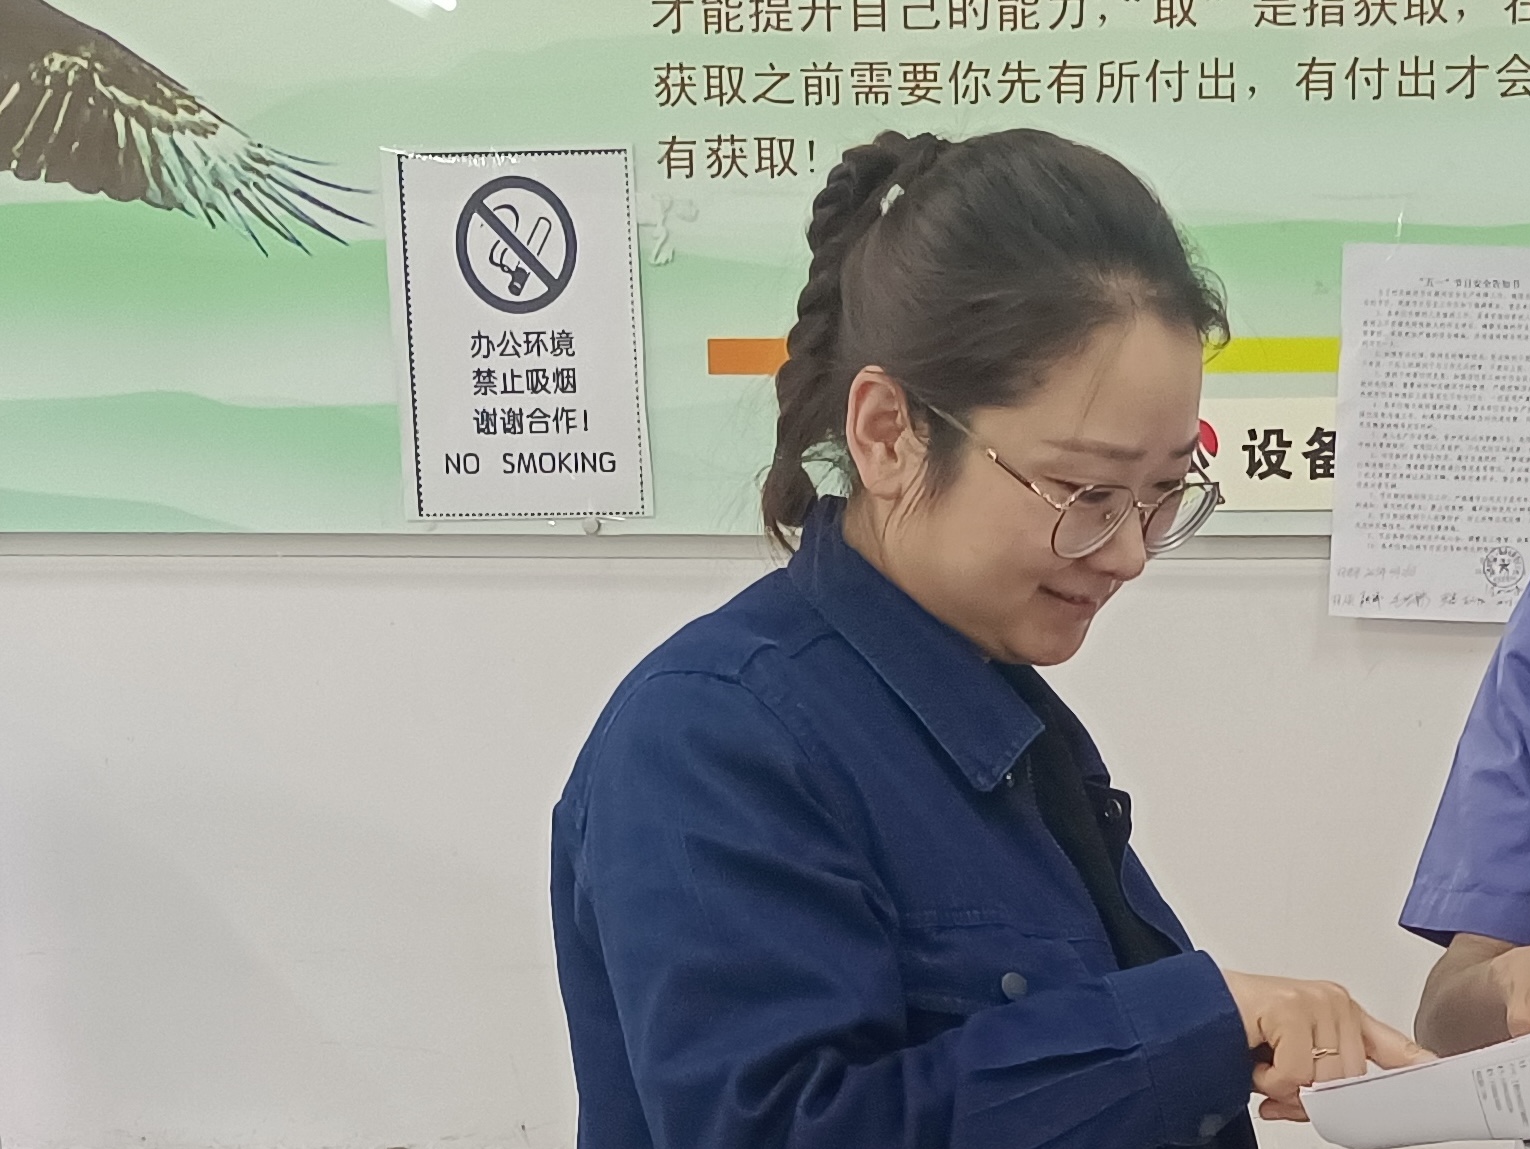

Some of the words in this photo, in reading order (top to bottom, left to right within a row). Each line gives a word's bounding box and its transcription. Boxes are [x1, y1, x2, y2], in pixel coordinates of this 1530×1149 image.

[470, 329, 576, 359] 办公环境
[472, 367, 577, 395] 禁止吸烟
[445, 453, 480, 474] NO
[502, 451, 616, 474] SMOKING
[1241, 426, 1337, 481] 设备
